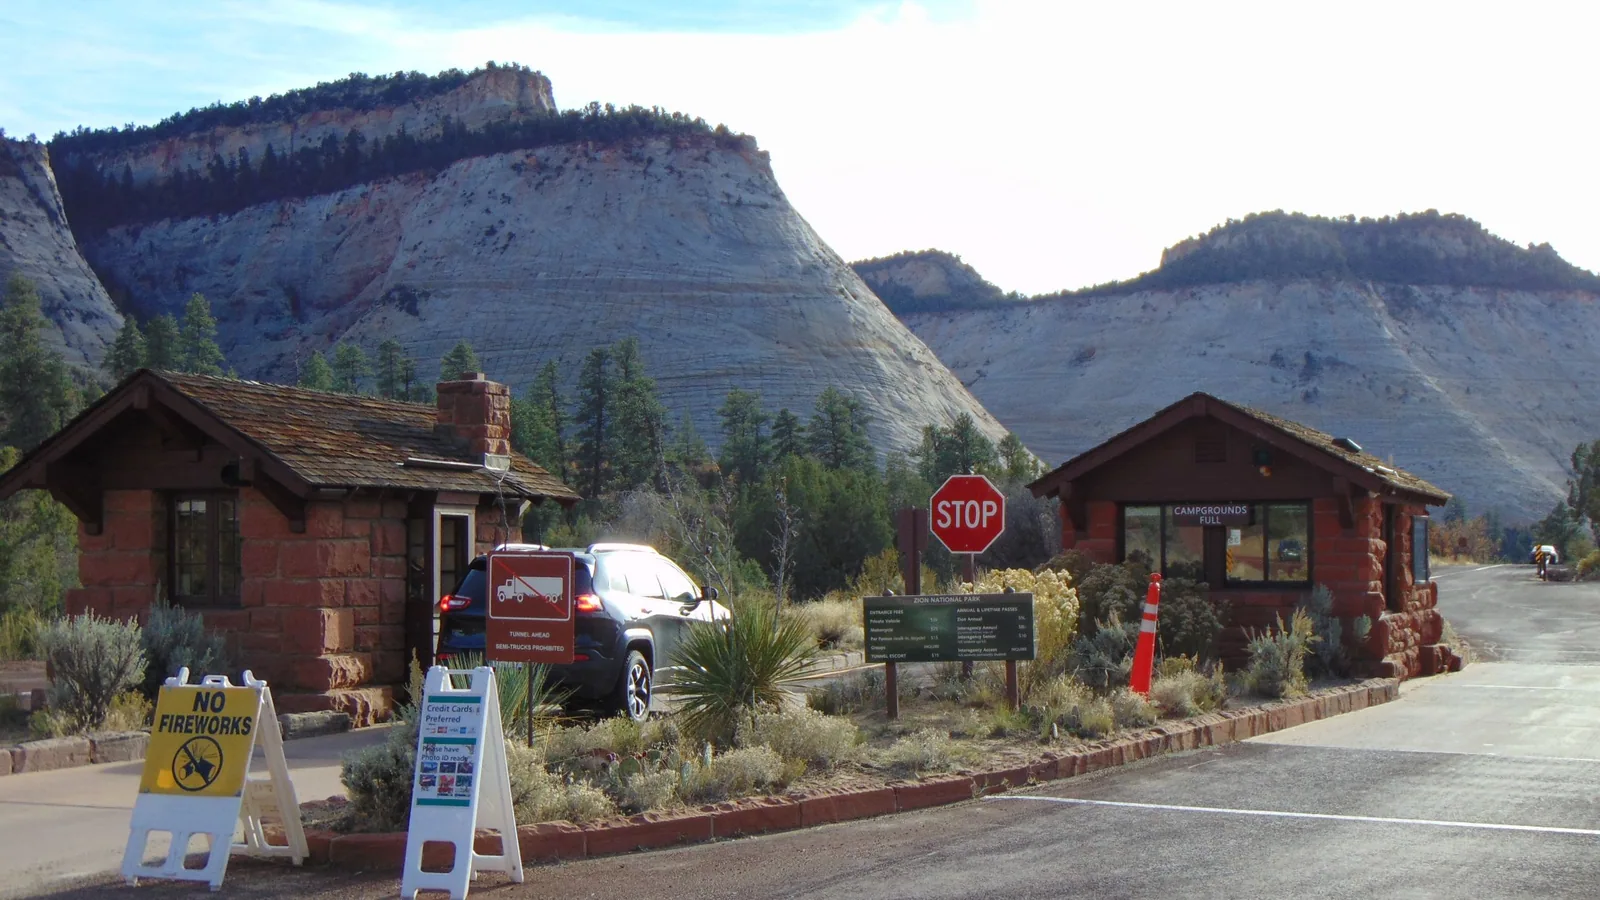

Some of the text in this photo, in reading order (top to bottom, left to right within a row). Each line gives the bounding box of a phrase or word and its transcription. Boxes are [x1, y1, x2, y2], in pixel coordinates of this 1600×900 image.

[937, 500, 997, 528] STOP
[1174, 506, 1247, 515] CAMPGROUNDS
[1200, 516, 1221, 524] FULL
[192, 691, 225, 713] NO
[158, 714, 252, 735] FIREWORKS
[425, 715, 461, 723] Preferred
